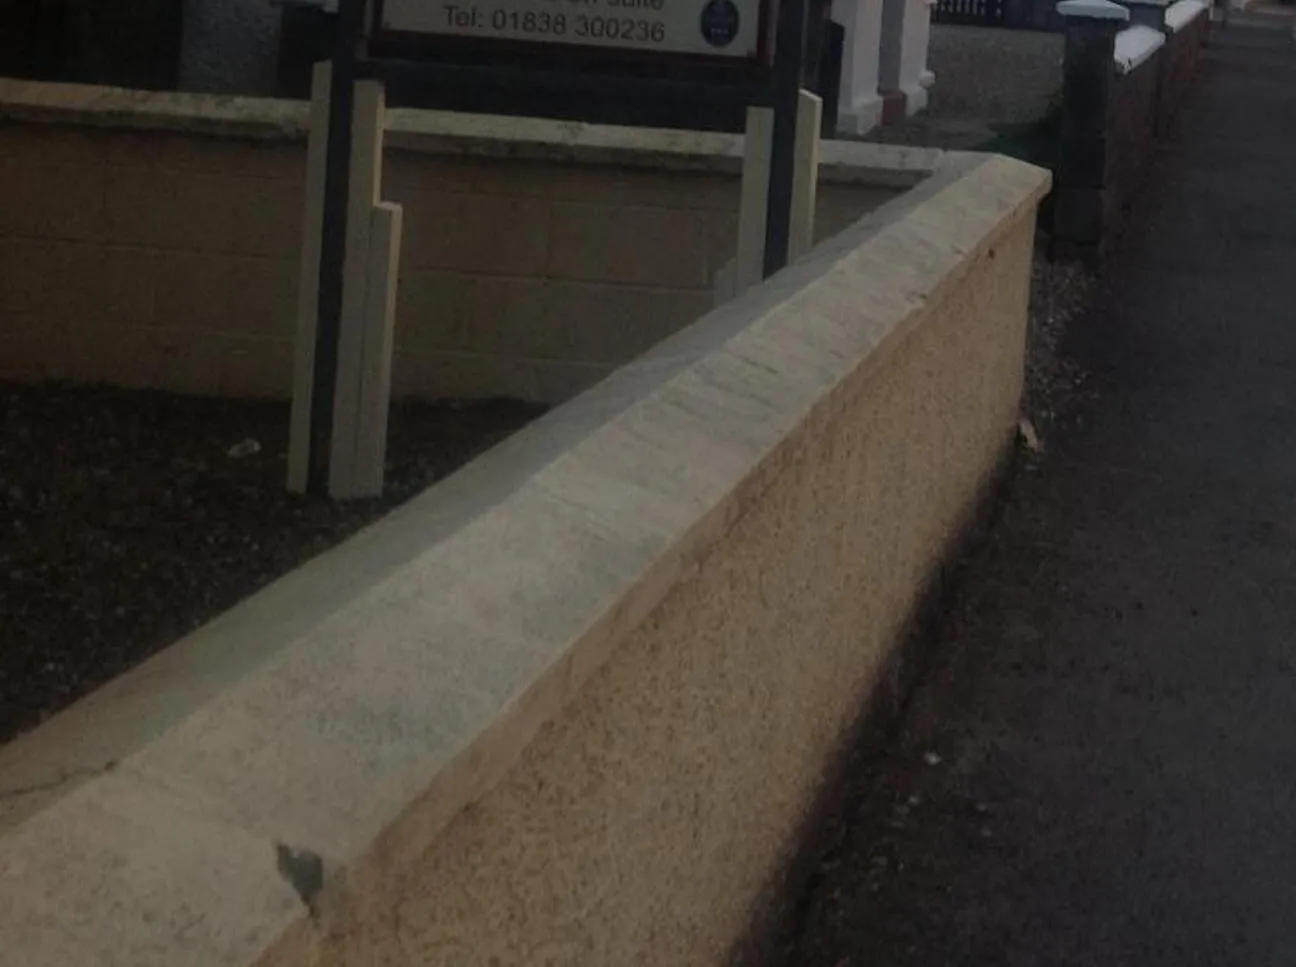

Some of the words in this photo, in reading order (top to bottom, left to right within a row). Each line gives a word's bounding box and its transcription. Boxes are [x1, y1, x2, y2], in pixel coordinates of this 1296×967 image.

[444, 6, 483, 27] Tel:
[492, 10, 566, 35] 01838
[575, 16, 665, 42] 300236
